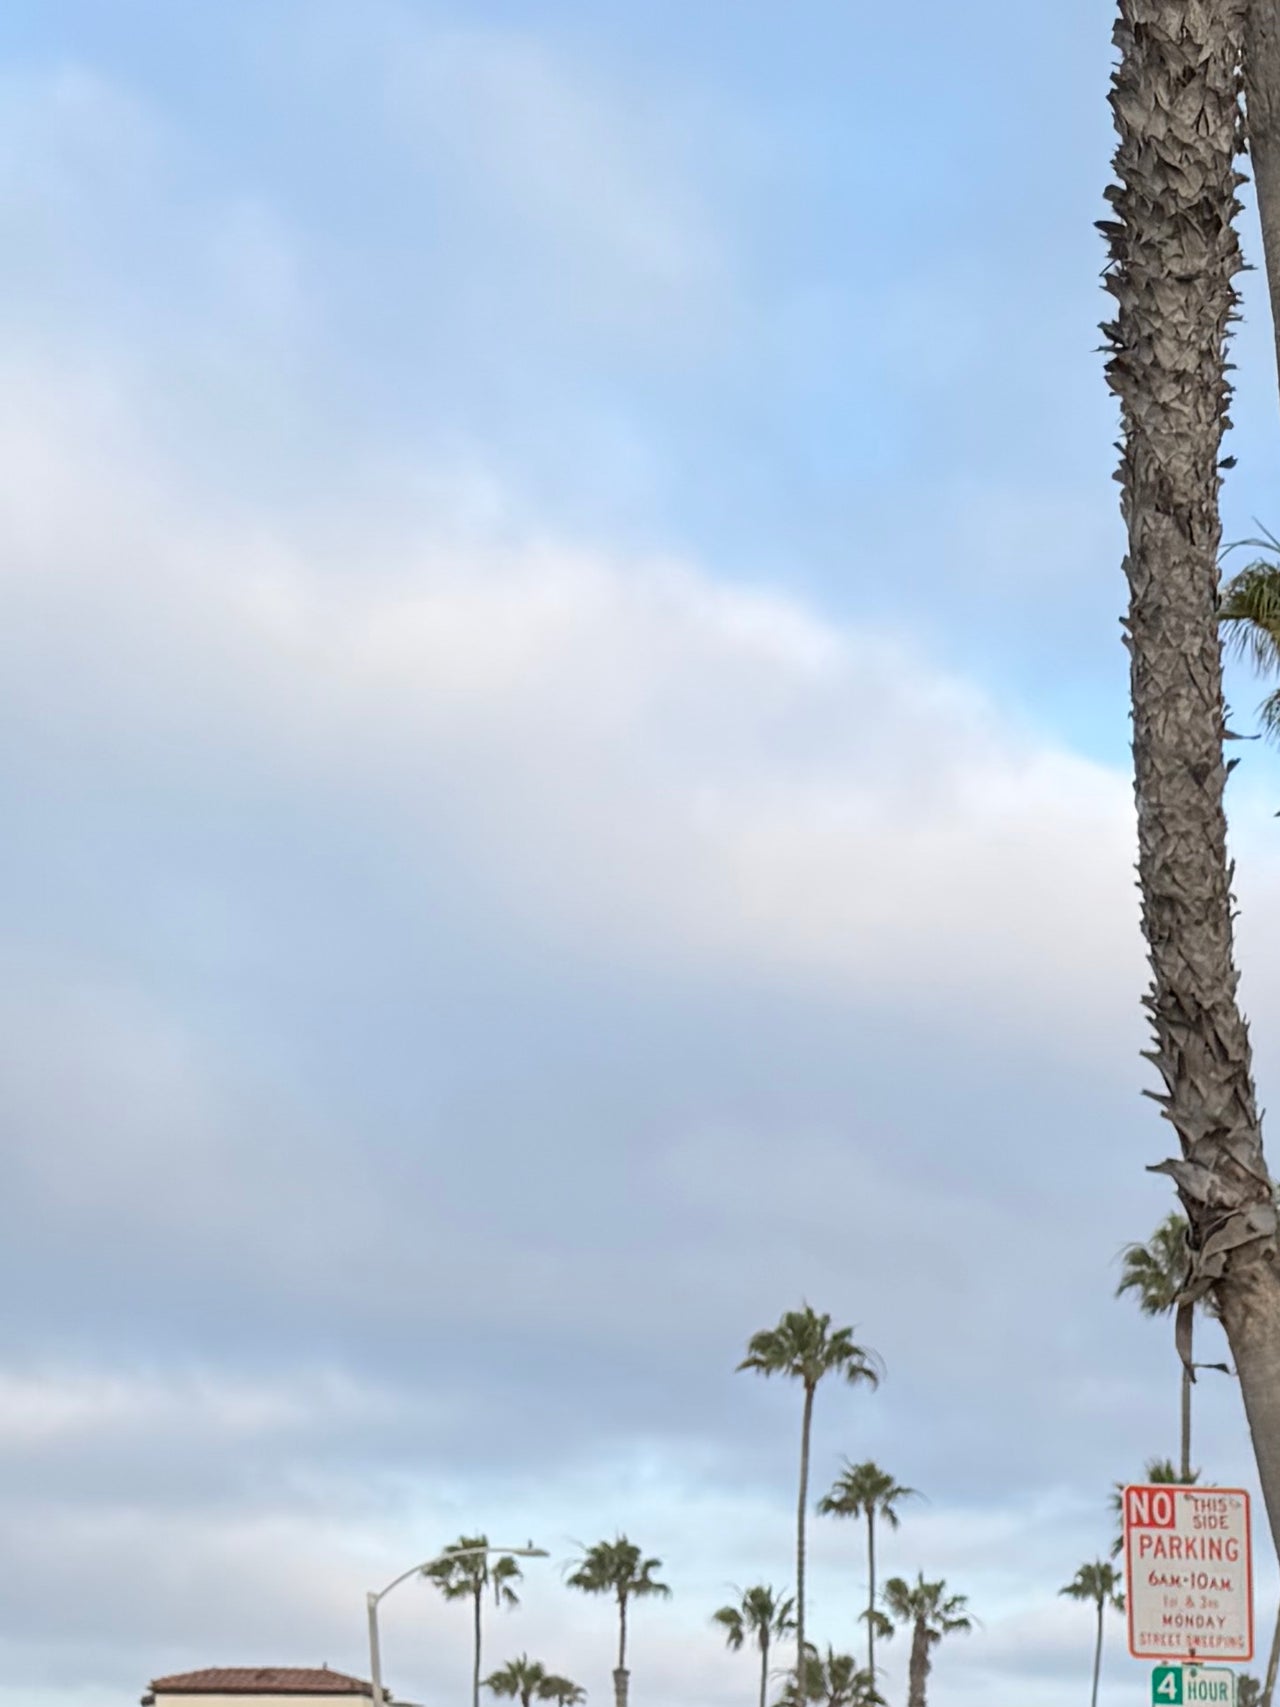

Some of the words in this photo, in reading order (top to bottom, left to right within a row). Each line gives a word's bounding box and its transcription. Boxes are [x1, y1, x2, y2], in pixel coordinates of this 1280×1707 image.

[1129, 1490, 1173, 1526] NO
[1192, 1498, 1227, 1513] THIS
[1193, 1515, 1230, 1530] SIDE
[1139, 1534, 1239, 1562] PARKING
[1162, 1614, 1226, 1629] MONDAY
[1157, 1671, 1178, 1700] 4
[1188, 1681, 1228, 1701] HOUR
